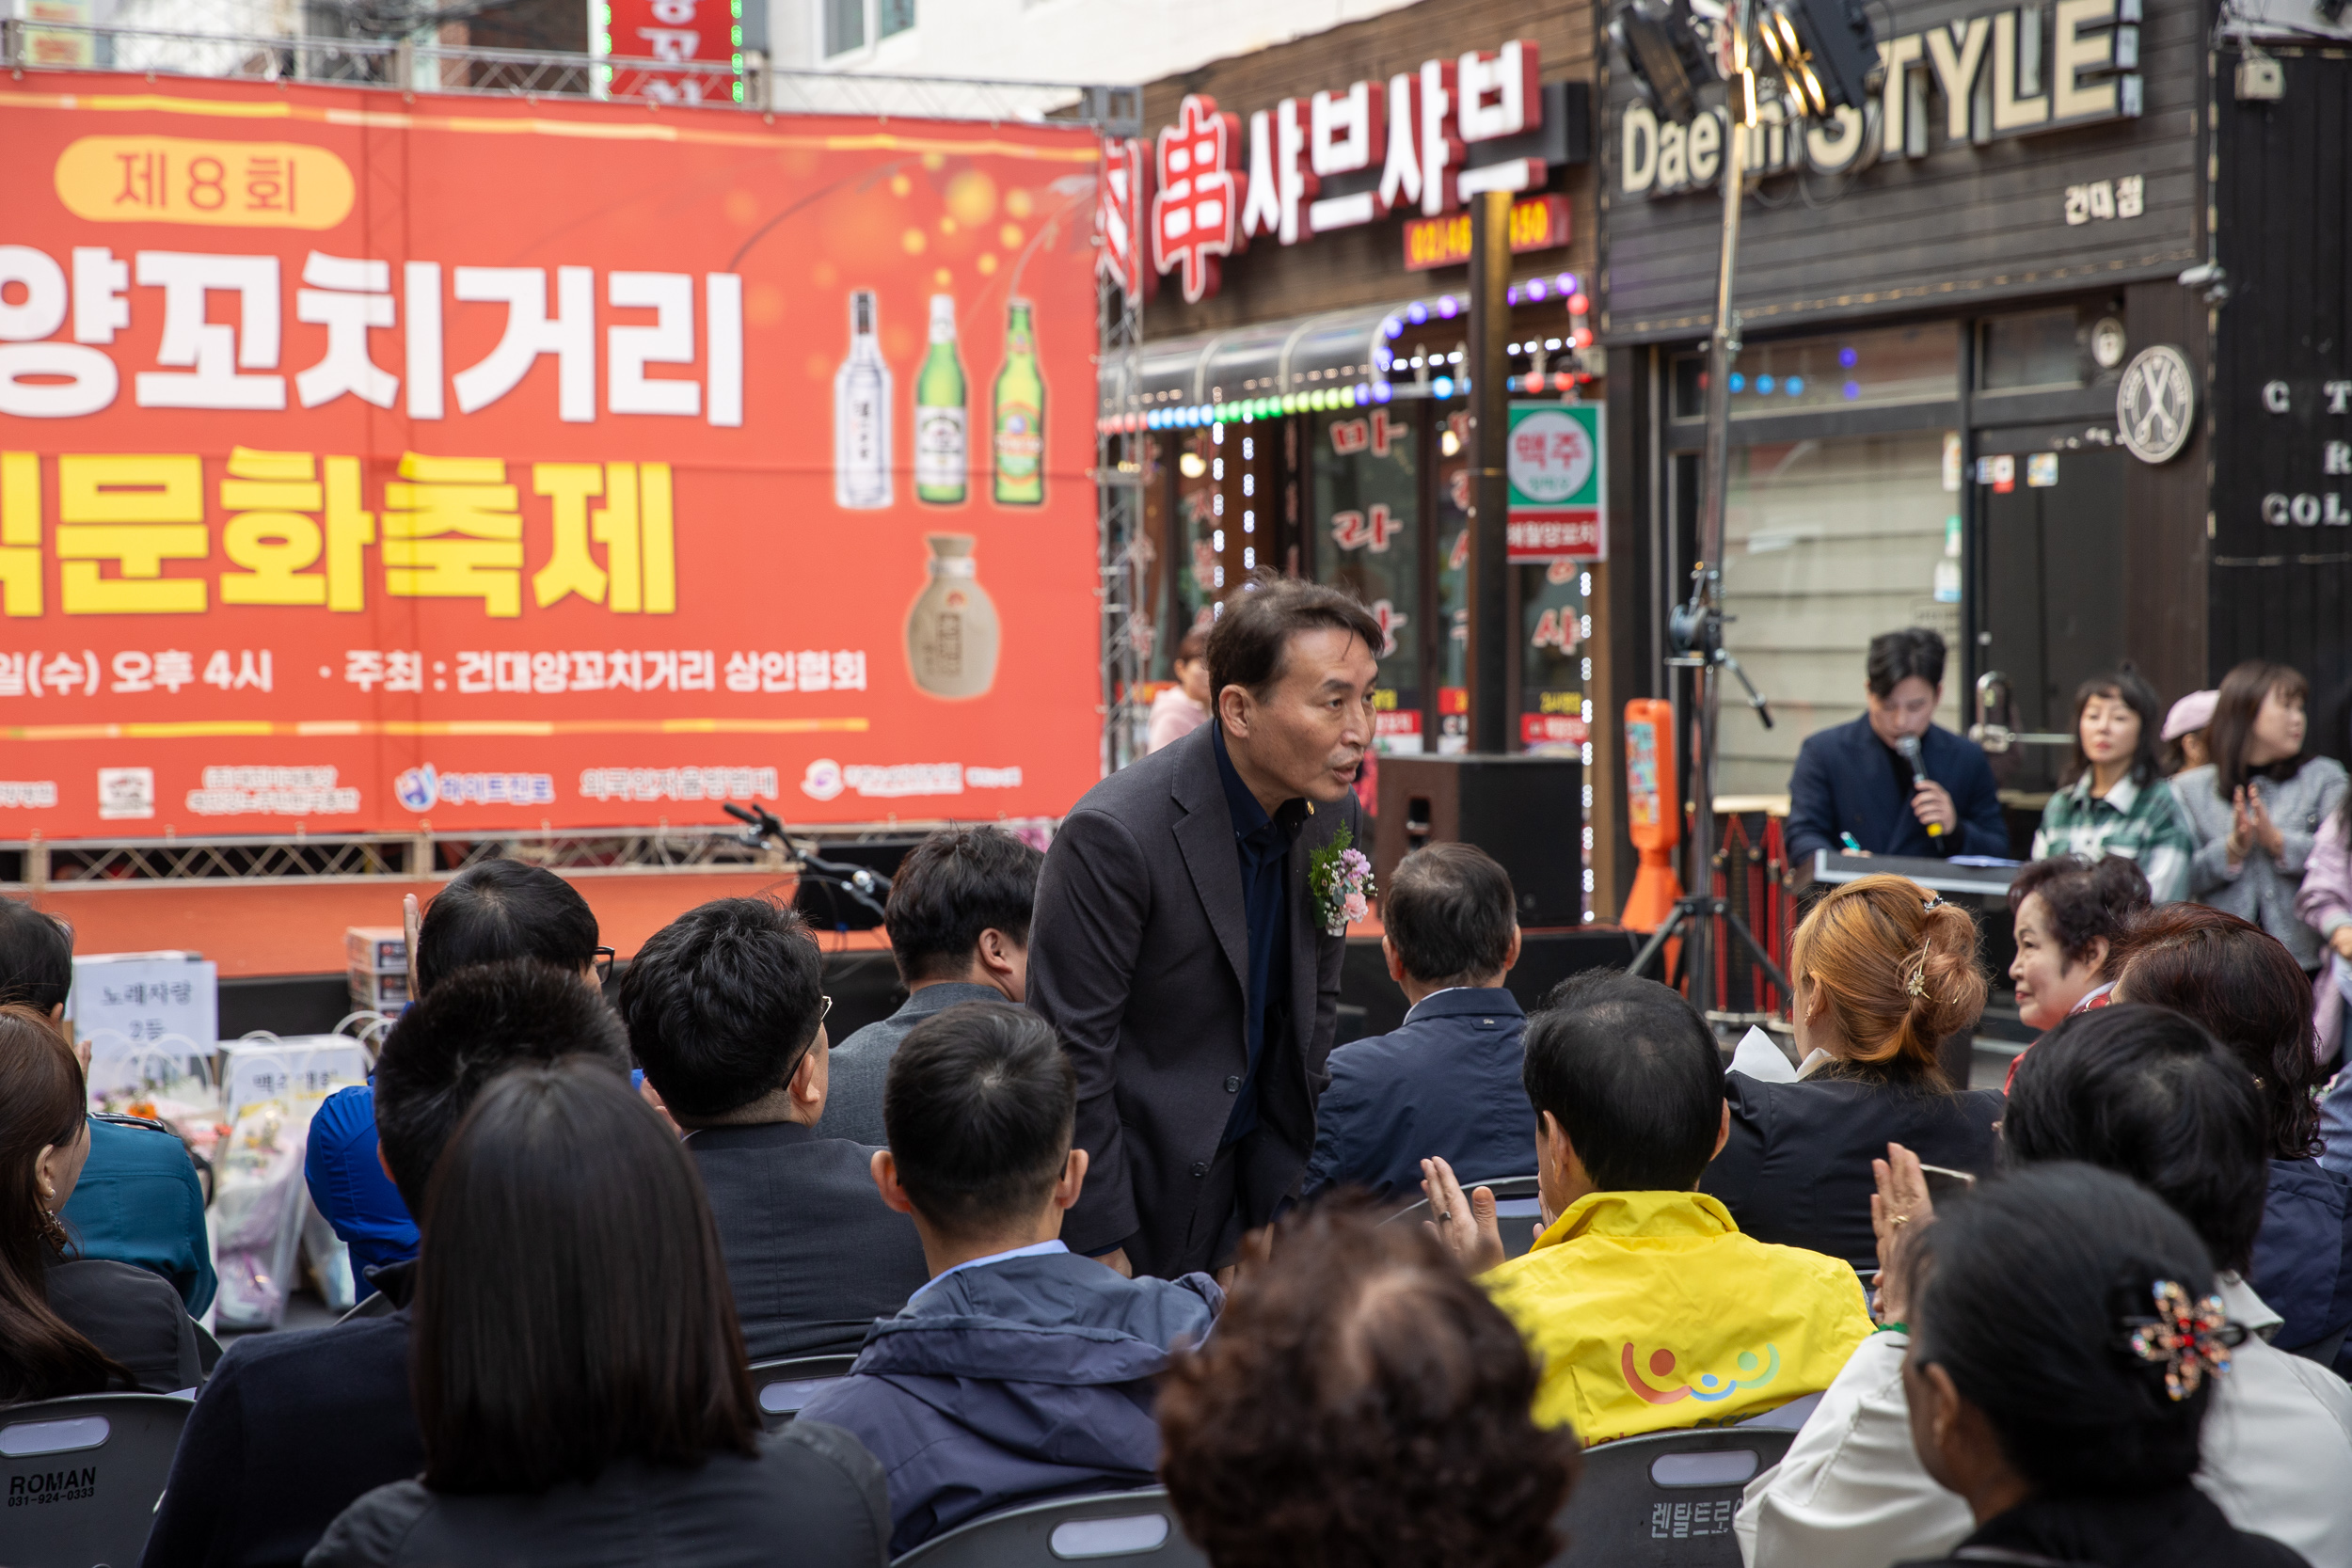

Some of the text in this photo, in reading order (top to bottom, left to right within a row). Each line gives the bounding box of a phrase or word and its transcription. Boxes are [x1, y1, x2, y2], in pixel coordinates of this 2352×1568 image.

[111, 648, 195, 694] 오후
[202, 649, 274, 693] 4시
[344, 649, 423, 693] 주최
[455, 648, 718, 694] 건대양꼬치거리
[723, 648, 868, 693] 상인협회
[101, 979, 193, 1007] 노래자랑
[9, 1466, 96, 1496] ROMAN
[8, 1486, 95, 1507] 031-924-0333
